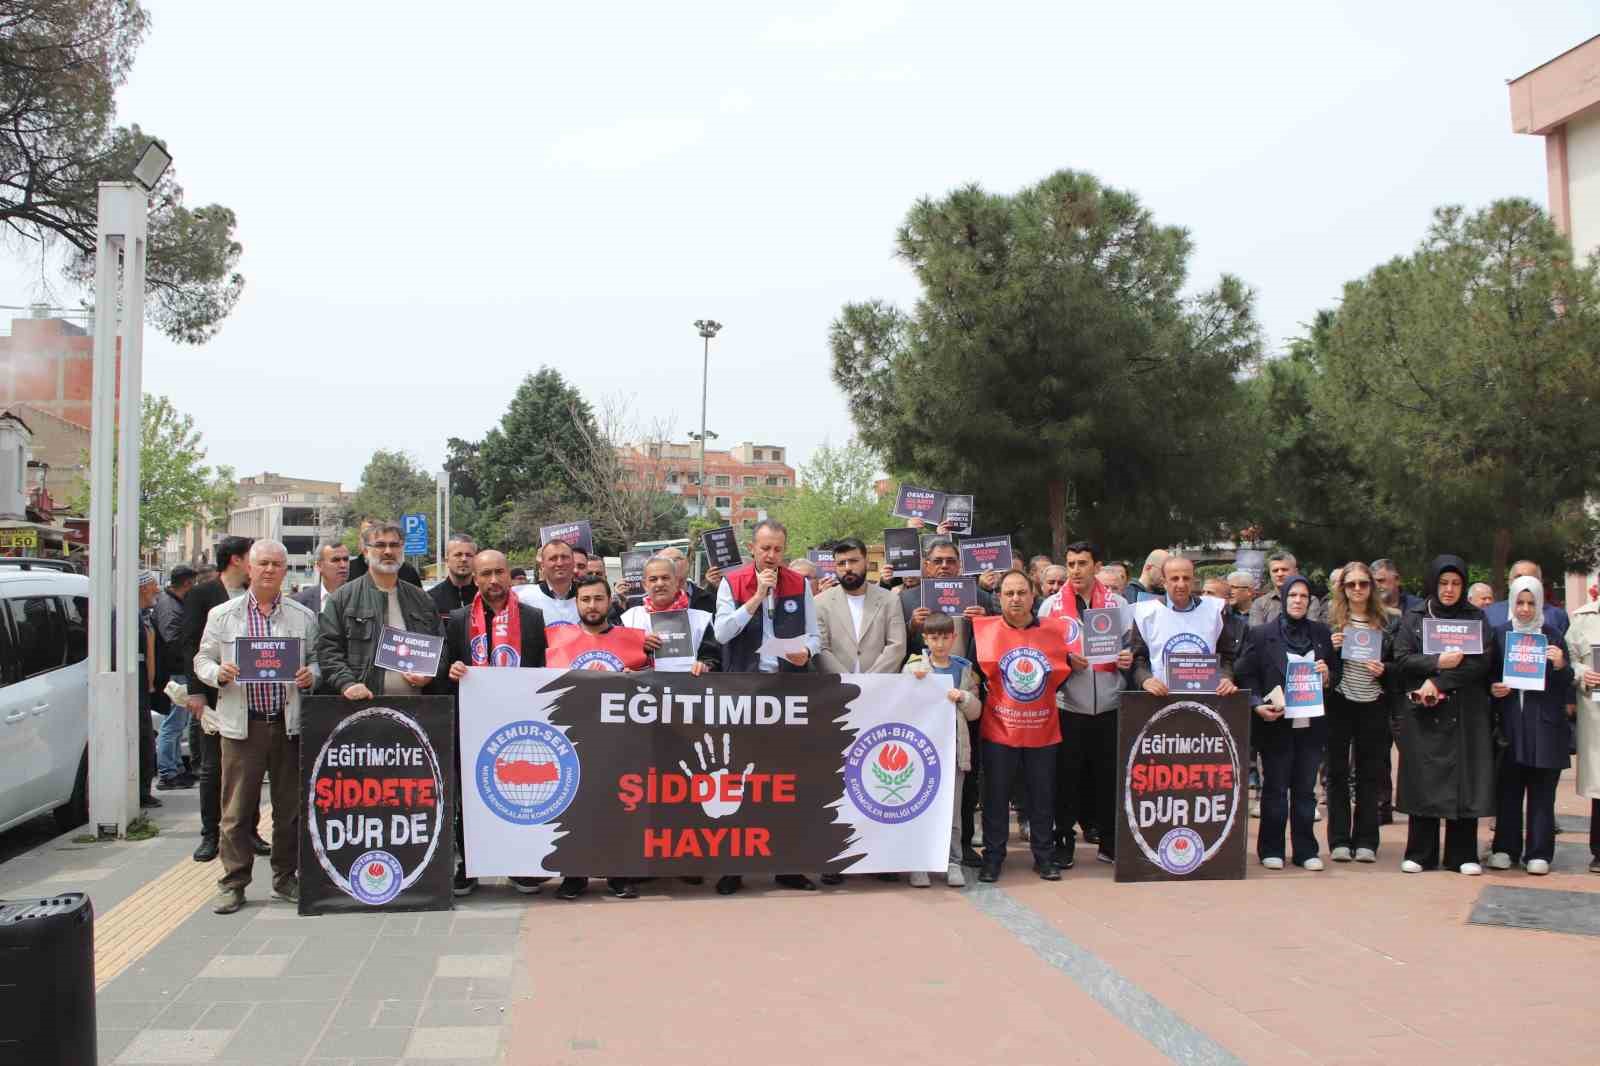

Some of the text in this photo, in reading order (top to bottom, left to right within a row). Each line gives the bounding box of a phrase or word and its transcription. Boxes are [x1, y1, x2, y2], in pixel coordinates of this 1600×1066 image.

[406, 516, 419, 533] P
[15, 537, 33, 546] 50
[599, 686, 810, 726] EĞİTİMDE
[327, 743, 424, 767] EĞİTİMCİYE
[487, 725, 570, 757] MEMUR-SEN
[1141, 733, 1225, 755] EĞİTİMCİYE
[314, 771, 436, 814] ŞİDDETE
[616, 767, 797, 811] ŞİDDETE
[1131, 759, 1234, 796] ŞİDDETE
[1140, 795, 1228, 828] DUR DE
[326, 812, 430, 850] DUR DE
[642, 827, 774, 858] HAYIR
